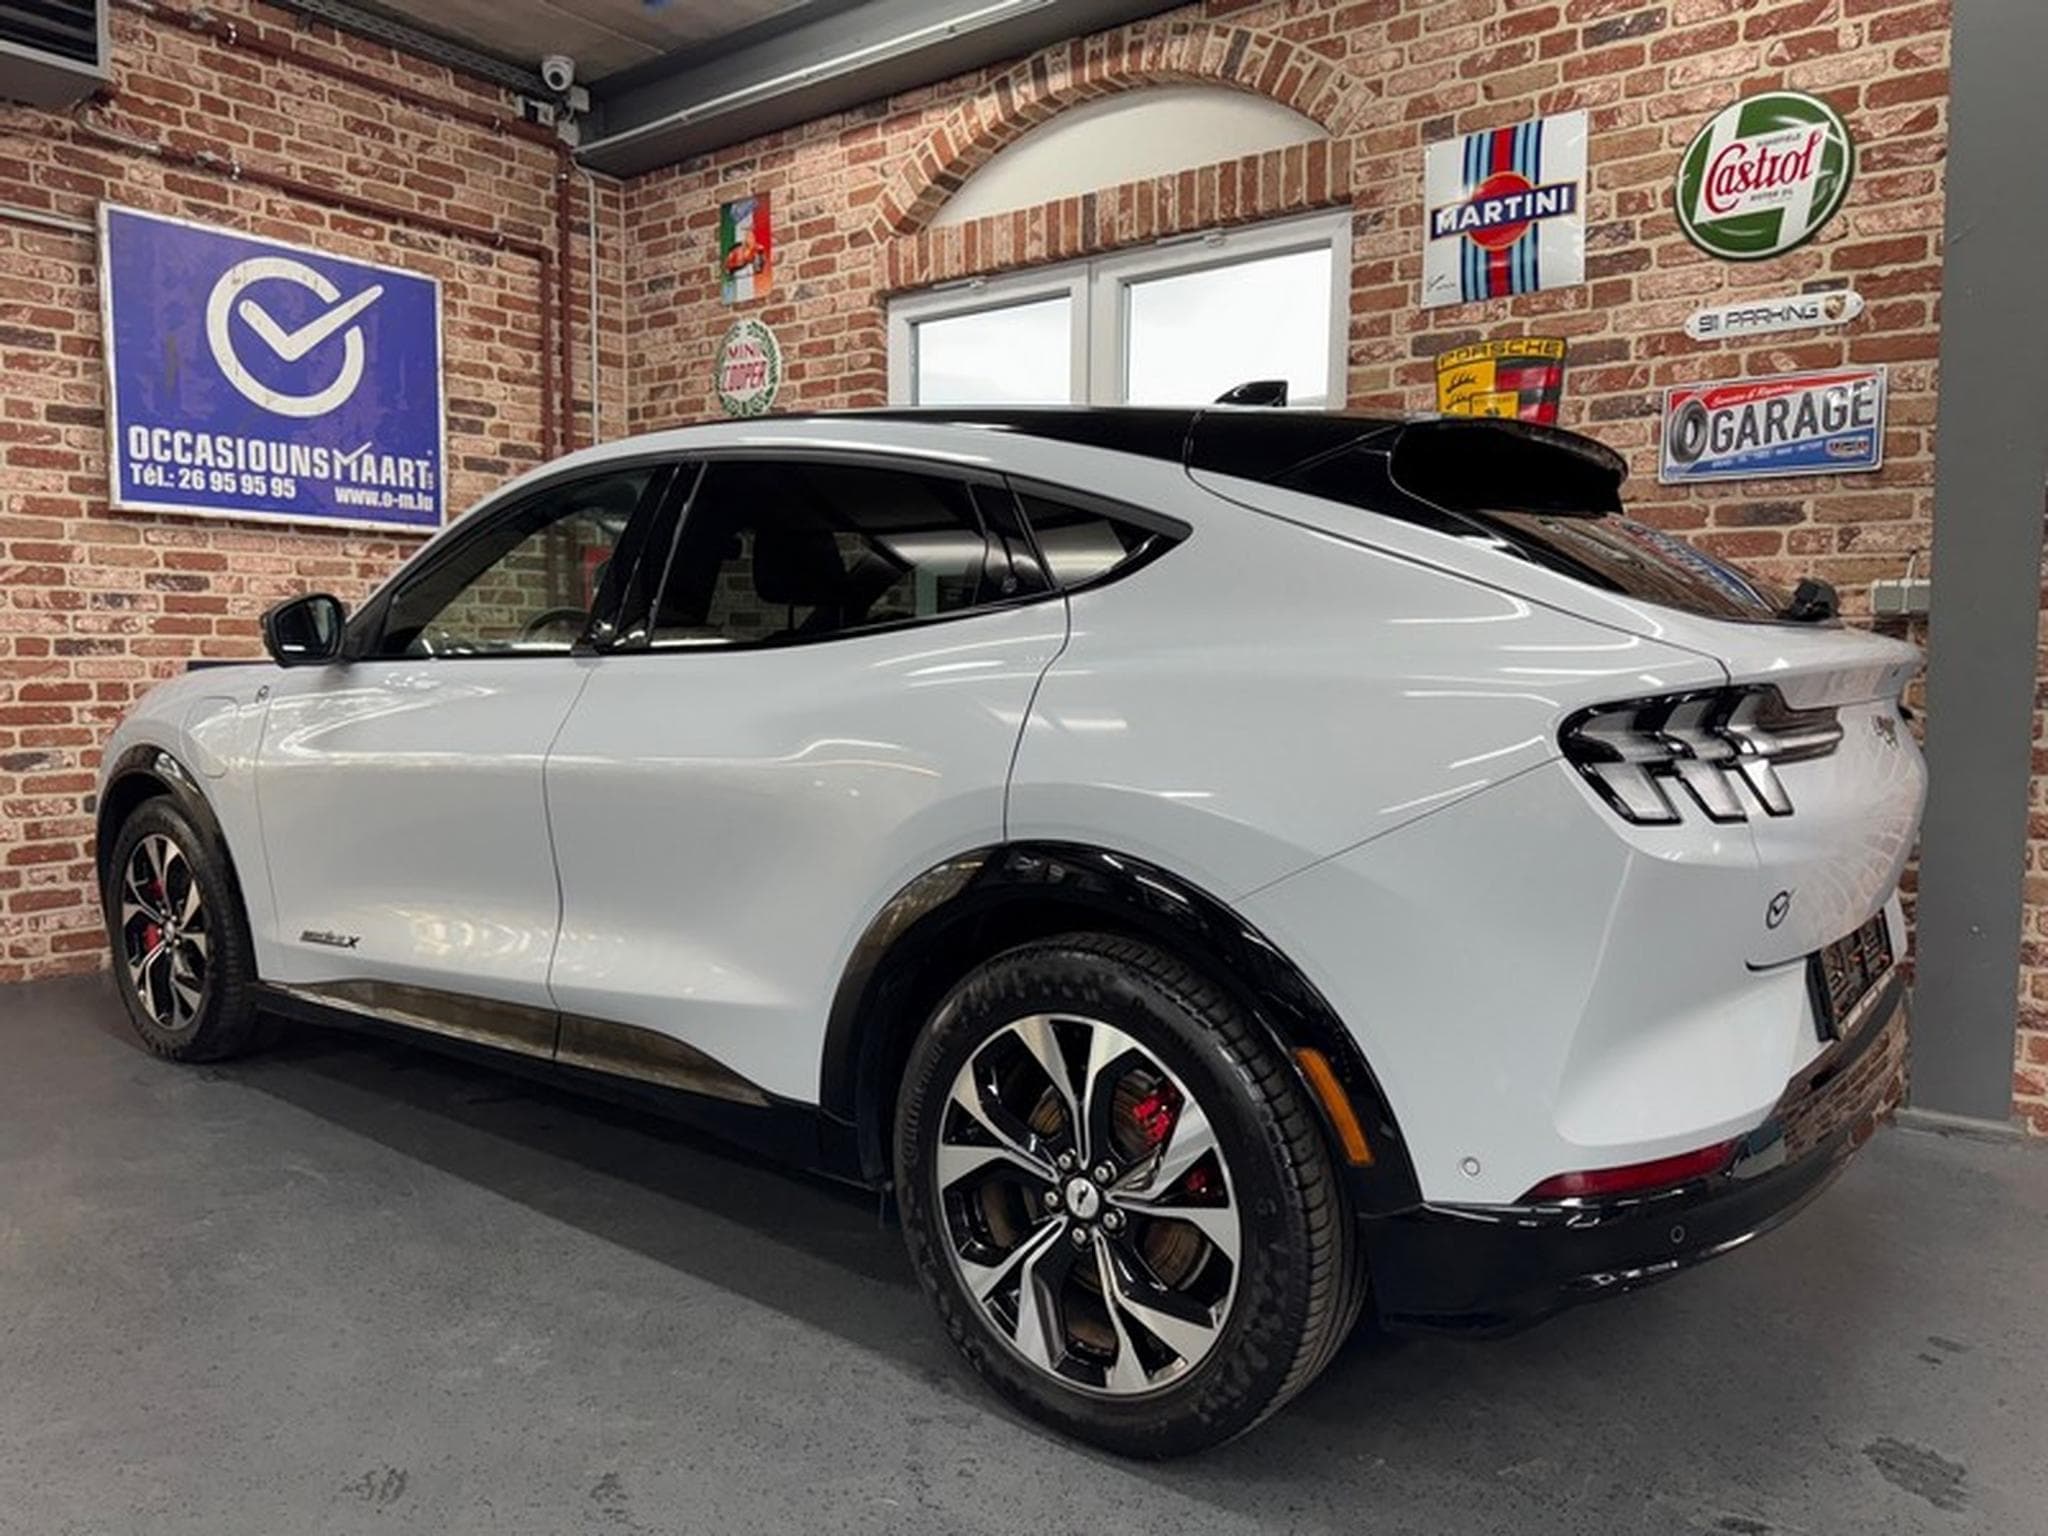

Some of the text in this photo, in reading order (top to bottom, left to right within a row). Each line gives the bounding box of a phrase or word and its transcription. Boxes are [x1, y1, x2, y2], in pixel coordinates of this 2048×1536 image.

[1704, 129, 1823, 214] Castrol
[1435, 187, 1569, 235] MARTINI
[1725, 303, 1819, 329] PARKING
[1711, 380, 1875, 453] GARAGE
[178, 467, 206, 491] 26
[209, 470, 237, 494] 95
[240, 474, 267, 497] 95
[270, 476, 297, 500] 95
[334, 486, 434, 512] www.o-m.lu
